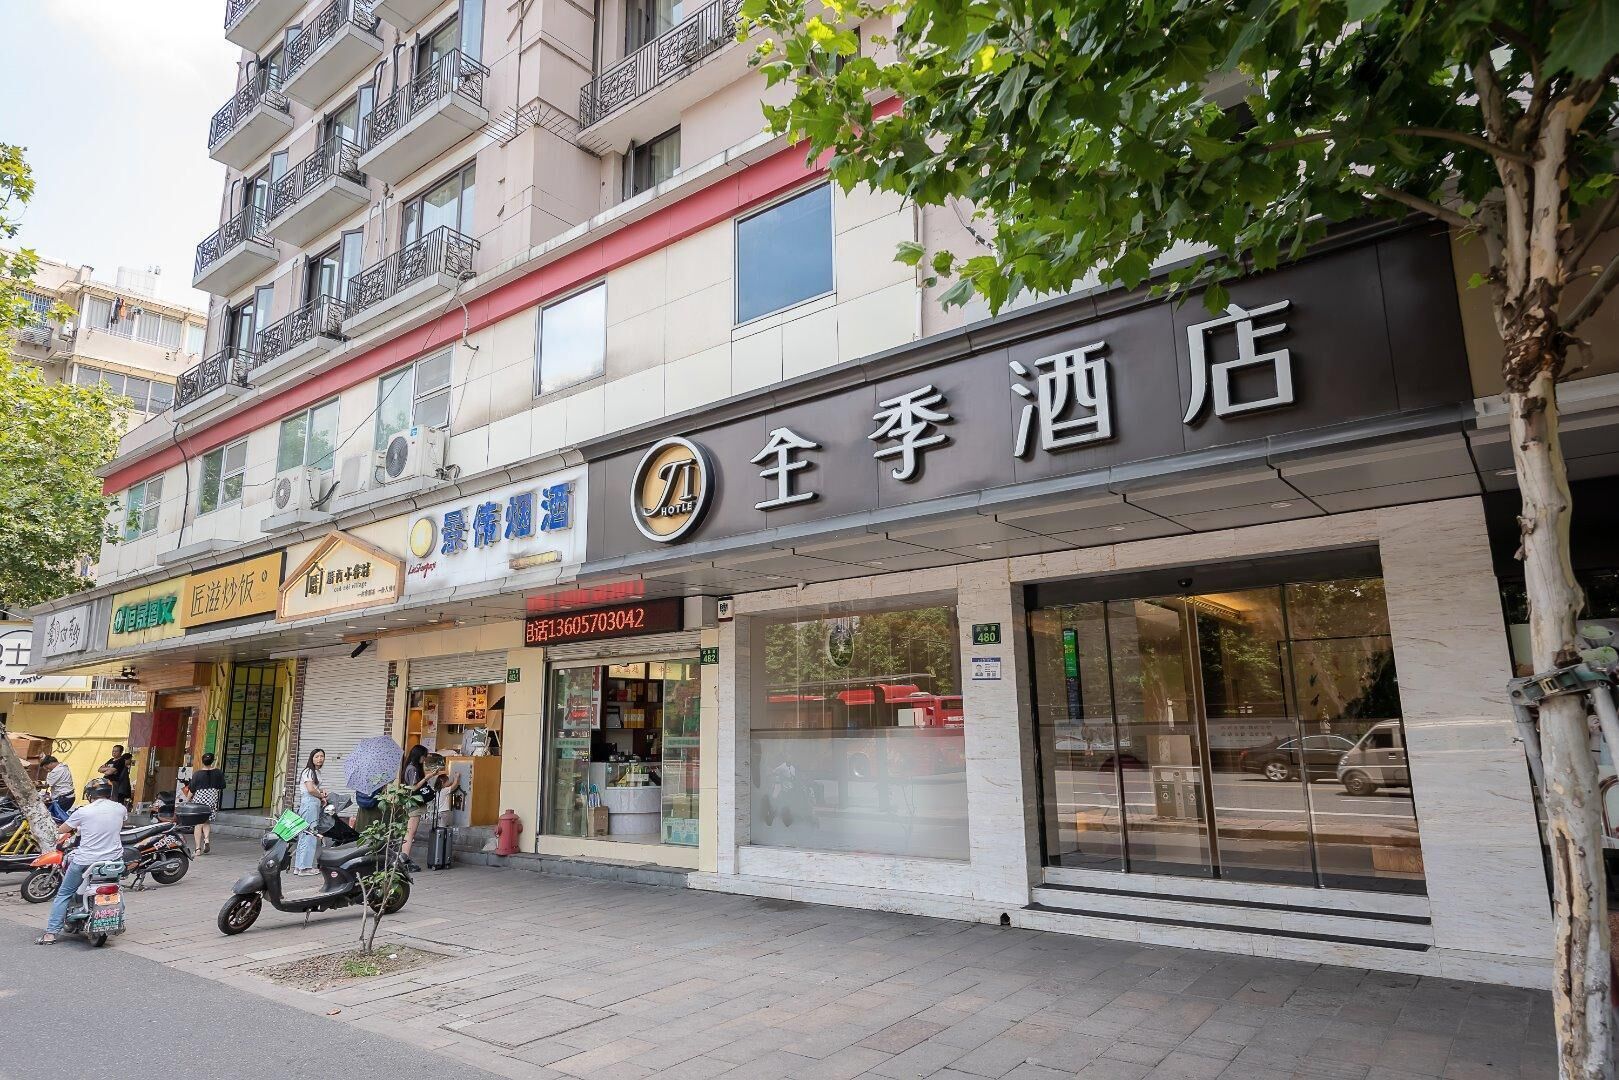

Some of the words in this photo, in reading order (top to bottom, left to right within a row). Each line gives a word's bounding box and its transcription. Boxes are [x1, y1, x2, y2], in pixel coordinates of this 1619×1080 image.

[750, 300, 1295, 511] 全季酒店
[661, 501, 693, 517] HOTLE
[191, 573, 255, 618] 匠滋炒饭
[977, 632, 996, 643] 480
[0, 643, 32, 667] 士
[703, 655, 716, 663] 482
